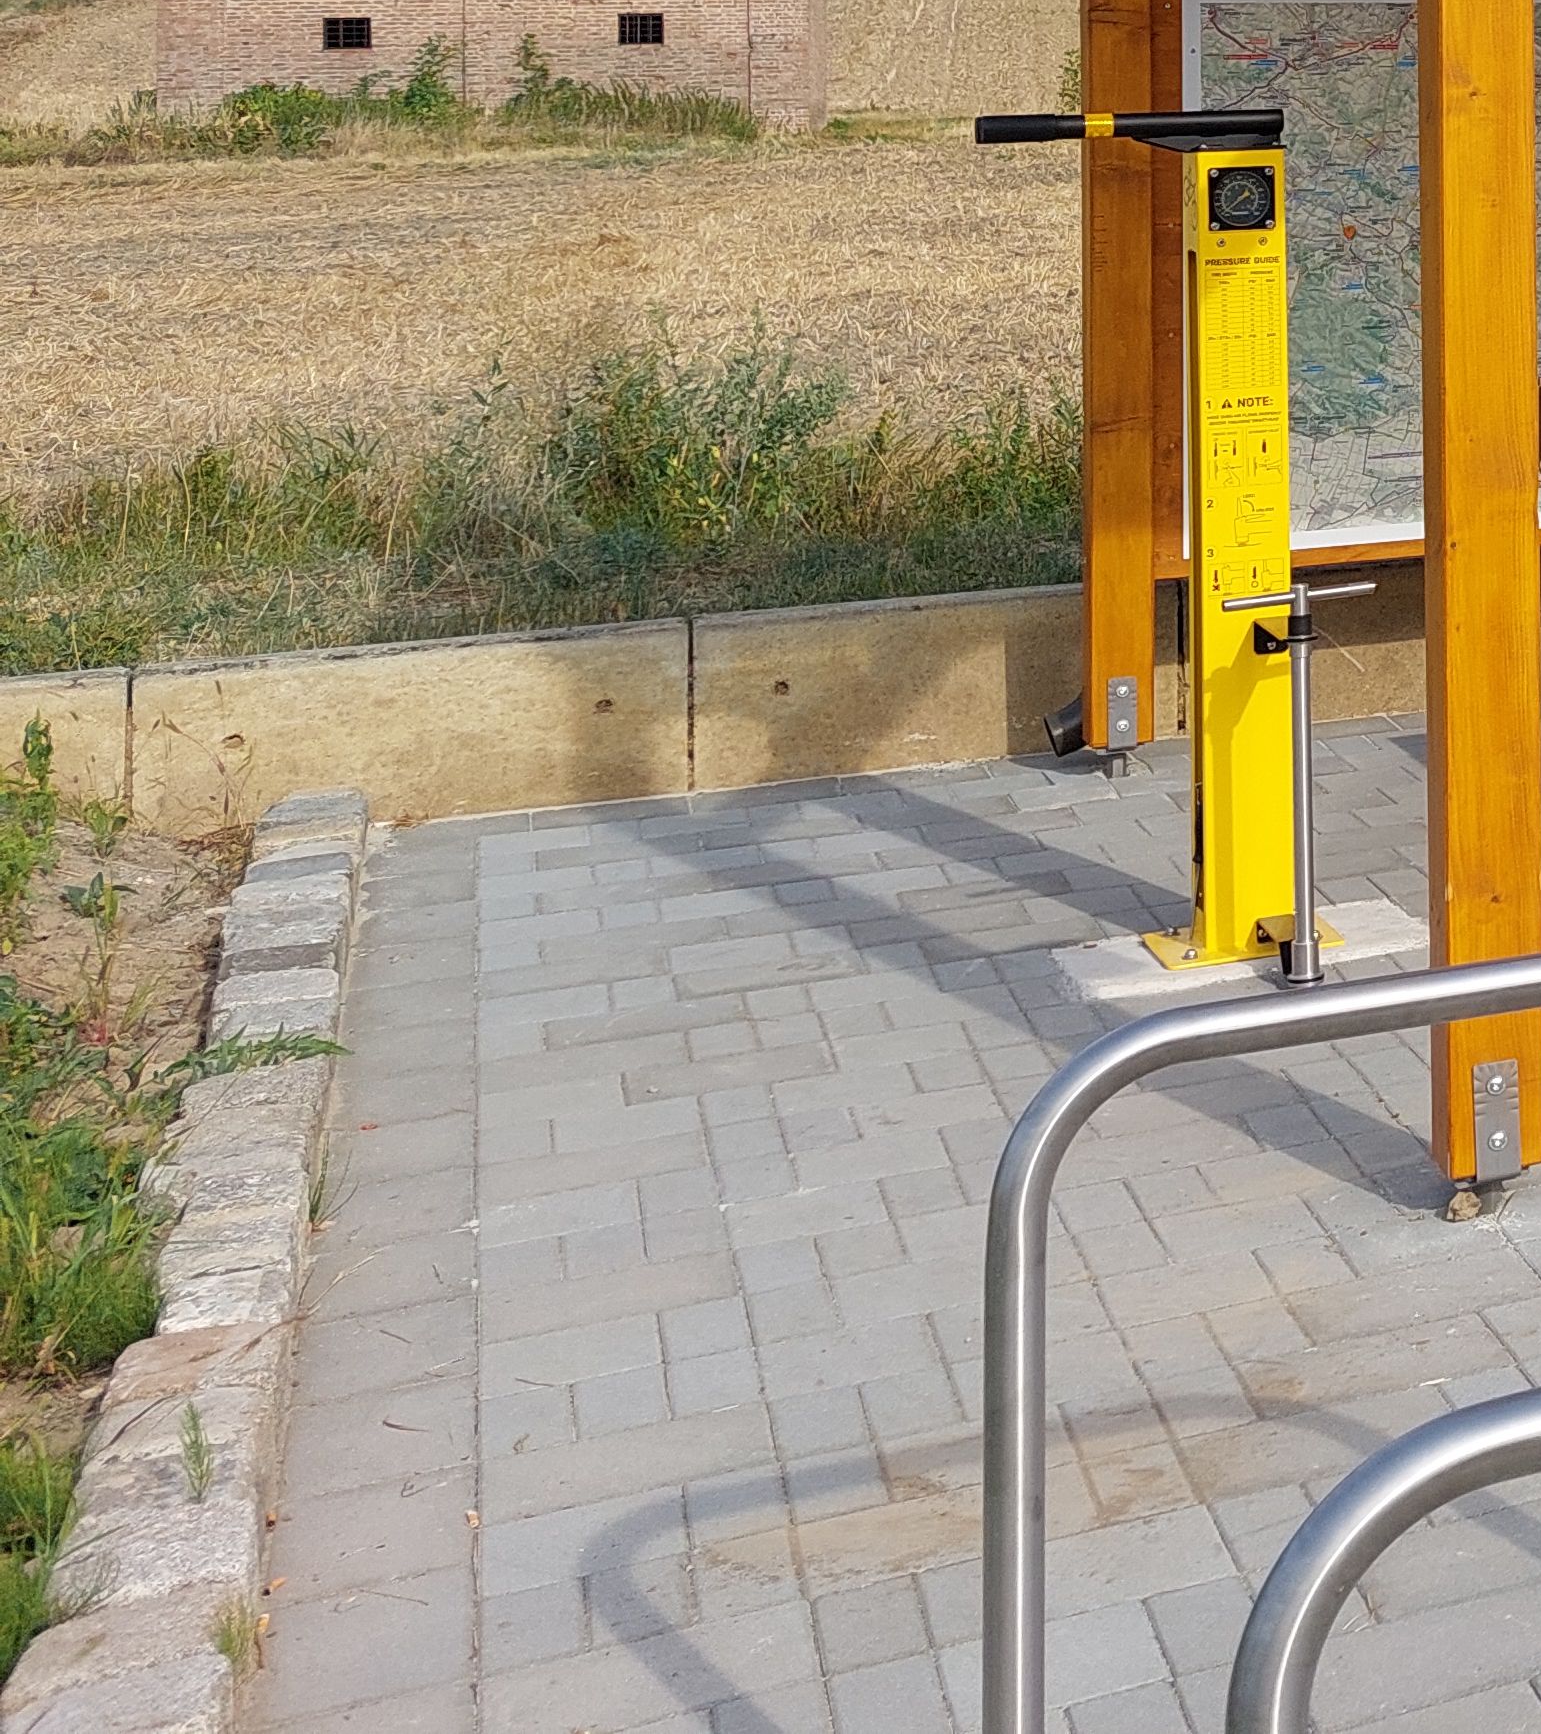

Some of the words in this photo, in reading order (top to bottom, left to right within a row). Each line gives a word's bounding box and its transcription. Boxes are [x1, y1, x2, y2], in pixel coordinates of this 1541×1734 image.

[1205, 258, 1250, 266] PRESSURE
[1254, 256, 1280, 264] GUIDE
[1206, 400, 1211, 409] 1
[1238, 396, 1274, 408] NOTE:
[1207, 500, 1214, 509] 2
[1206, 549, 1214, 557] 3
